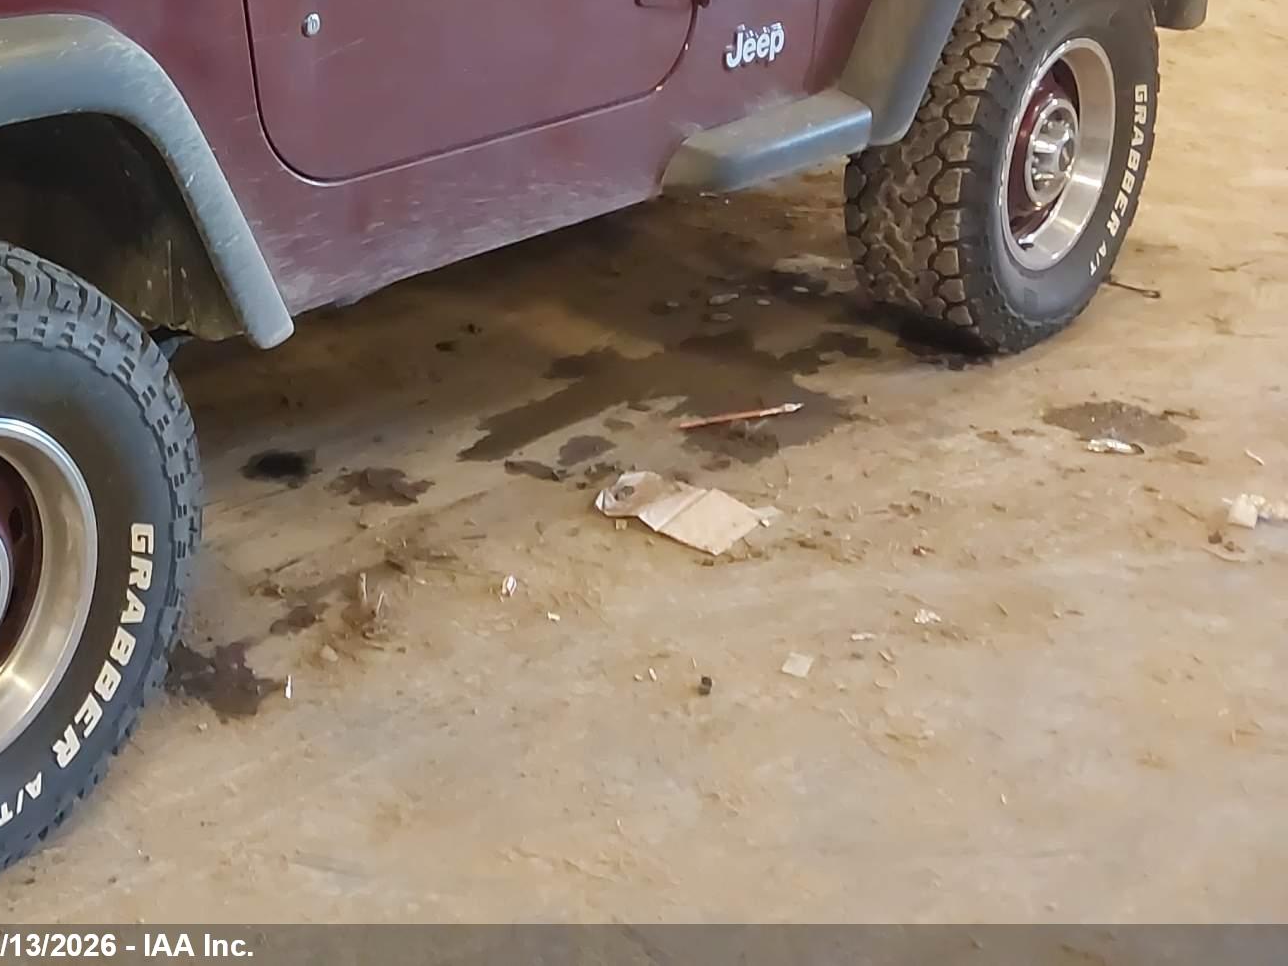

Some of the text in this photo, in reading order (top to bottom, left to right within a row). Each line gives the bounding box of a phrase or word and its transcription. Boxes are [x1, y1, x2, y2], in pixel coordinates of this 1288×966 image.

[725, 22, 785, 68] Jeep
[1089, 83, 1148, 276] GRABBER A/T
[52, 522, 155, 768] GRABBER
